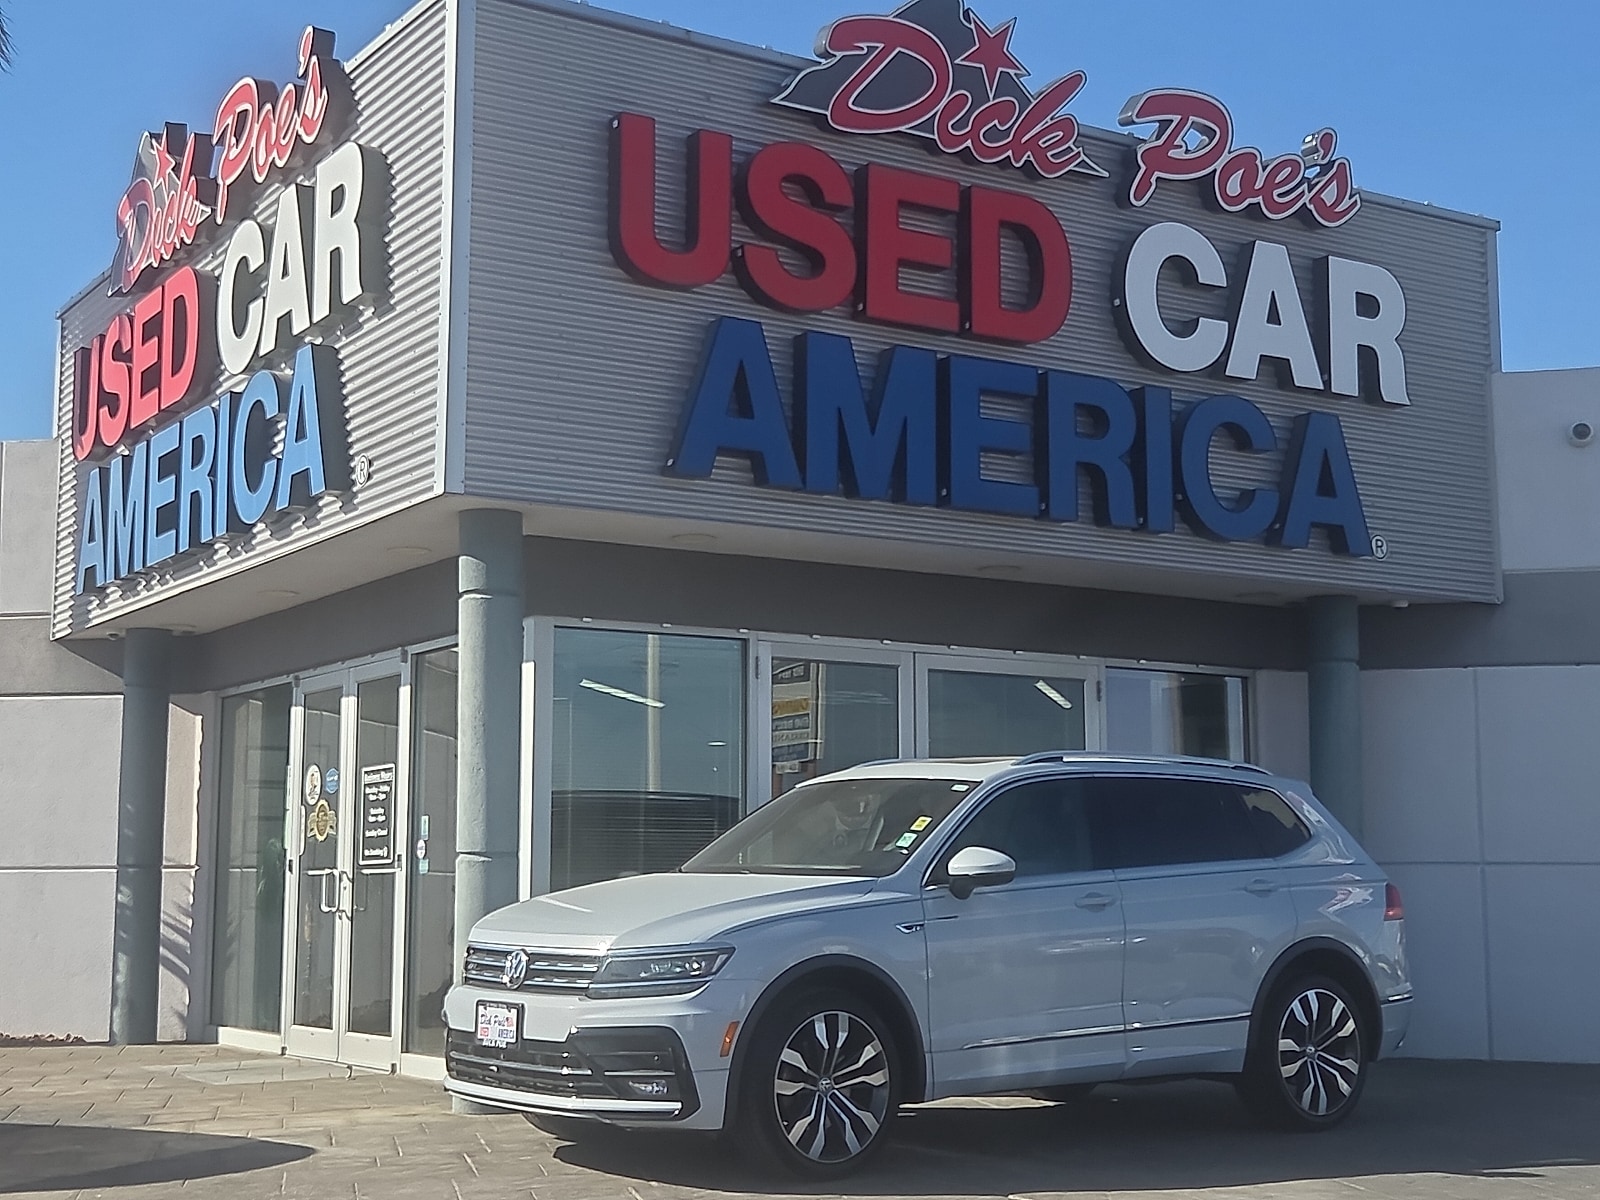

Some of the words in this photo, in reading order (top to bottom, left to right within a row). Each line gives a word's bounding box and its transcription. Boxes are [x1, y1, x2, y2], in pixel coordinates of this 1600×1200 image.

[117, 131, 206, 293] Dick
[213, 26, 329, 225] Poe's
[821, 14, 1086, 178] Dick
[1124, 87, 1363, 228] Poe's
[74, 266, 200, 461] USED
[217, 141, 364, 375] CAR
[610, 112, 1074, 345] USED
[1120, 221, 1411, 406] CAR
[76, 344, 327, 596] AMERICA
[665, 316, 1372, 558] AMERICA
